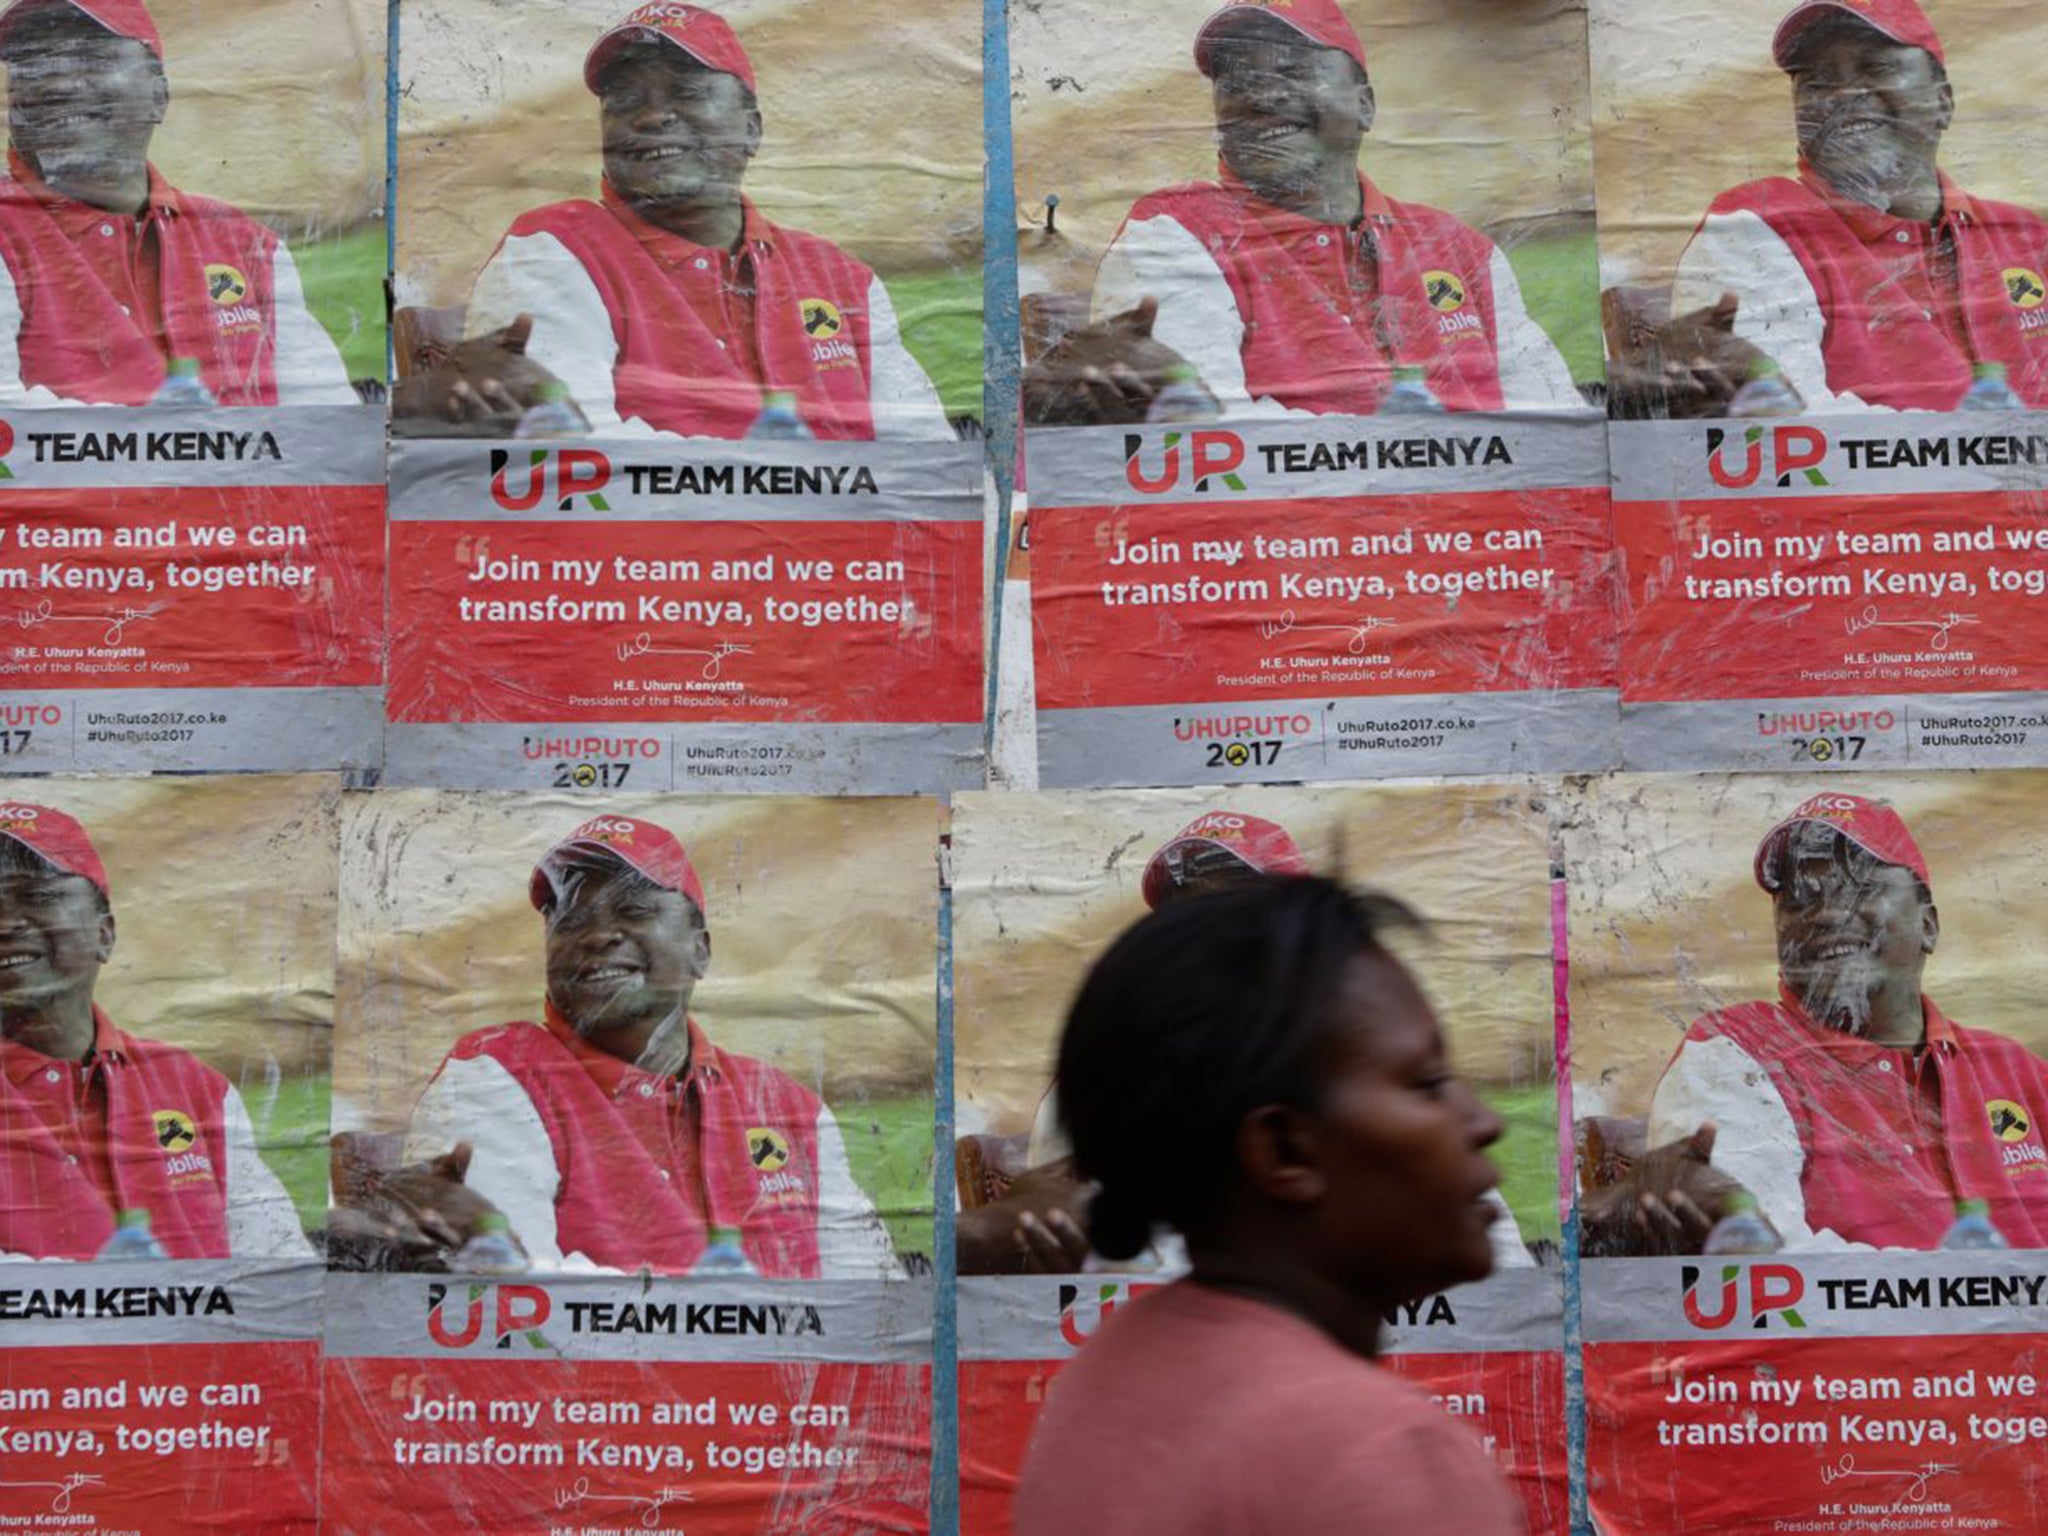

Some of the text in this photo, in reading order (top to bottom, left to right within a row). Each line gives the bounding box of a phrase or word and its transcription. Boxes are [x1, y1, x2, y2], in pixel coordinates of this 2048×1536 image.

[28, 432, 137, 463] TEAM
[146, 430, 283, 461] KENYA
[1125, 430, 1514, 494] UR TEAM KENYA
[1706, 425, 1831, 488] UR
[1840, 437, 1950, 469] TEAM
[490, 448, 879, 512] UR TEAM KENYA
[17, 521, 102, 549] team
[113, 521, 176, 548] and
[188, 525, 237, 546] we
[247, 525, 307, 546] can
[1193, 537, 1243, 565] my
[1254, 533, 1340, 561] team
[1351, 527, 1413, 557] and
[1424, 530, 1474, 554] we
[1485, 529, 1543, 552] can
[1776, 534, 1824, 562] my
[1837, 530, 1921, 555] team
[1933, 526, 1994, 552] and
[2006, 529, 2048, 550] we
[40, 562, 155, 593] Kenya,
[166, 560, 316, 592] together
[553, 559, 601, 588] my
[614, 556, 699, 582] team
[711, 555, 774, 582] and
[785, 559, 835, 582] we
[846, 559, 905, 582] can
[1102, 564, 1555, 606] transform Kenya, together
[1685, 572, 1851, 600] transform
[1863, 569, 1977, 598] Kenya,
[459, 595, 914, 628] transform Kenya, together
[15, 645, 146, 661] H.E. Uhuru Kenyatta
[34, 662, 47, 673] of
[51, 661, 72, 673] the
[75, 662, 131, 675] Republic
[135, 661, 148, 673] of
[151, 660, 191, 675] Kenya
[1260, 653, 1391, 669] H.E. Uhuru Kenyatta
[1844, 650, 1974, 665] H.E. Uhuru Kenyatta
[613, 680, 744, 694] H.E. Uhuru Kenyatta
[1216, 667, 1437, 686] President of the Republic of Kenya
[1800, 665, 2019, 681] President of the Republic of Kenya
[569, 695, 789, 709] President of the Republic of Kenya
[1337, 716, 1477, 733] UhuRuto2017.co.ke
[1920, 714, 2048, 731] UhuRuto2017.co.k
[1206, 741, 1283, 768] 2017
[1338, 735, 1444, 751] #UhuRuto2017
[1921, 732, 2026, 748] #UhuRuto2017
[0, 1286, 235, 1319] EAM KENYA
[1382, 1293, 1456, 1326] NYA
[1681, 1264, 2048, 1330] UR TEAM KENY
[427, 1283, 826, 1349] UR TEAM KENYA
[0, 1380, 261, 1411] am and we can
[1750, 1377, 1802, 1407] my
[1813, 1374, 1901, 1401] team
[1912, 1369, 1976, 1399] and
[1987, 1374, 2037, 1397] we
[489, 1398, 540, 1430] my
[553, 1396, 641, 1425] team
[652, 1397, 716, 1426] and
[728, 1402, 778, 1426] we
[790, 1403, 850, 1429] can
[1658, 1412, 2048, 1446] transform Kenya, toge
[116, 1420, 271, 1455] together
[394, 1436, 859, 1475] transform Kenya, together
[0, 1513, 95, 1528] huru Kenyatta
[1775, 1519, 1834, 1532] President
[1881, 1516, 1938, 1531] Republic
[1941, 1515, 1955, 1528] of
[1958, 1514, 1998, 1530] Kenya
[1819, 1501, 1951, 1516] H.E. Uhuru Kenyatta
